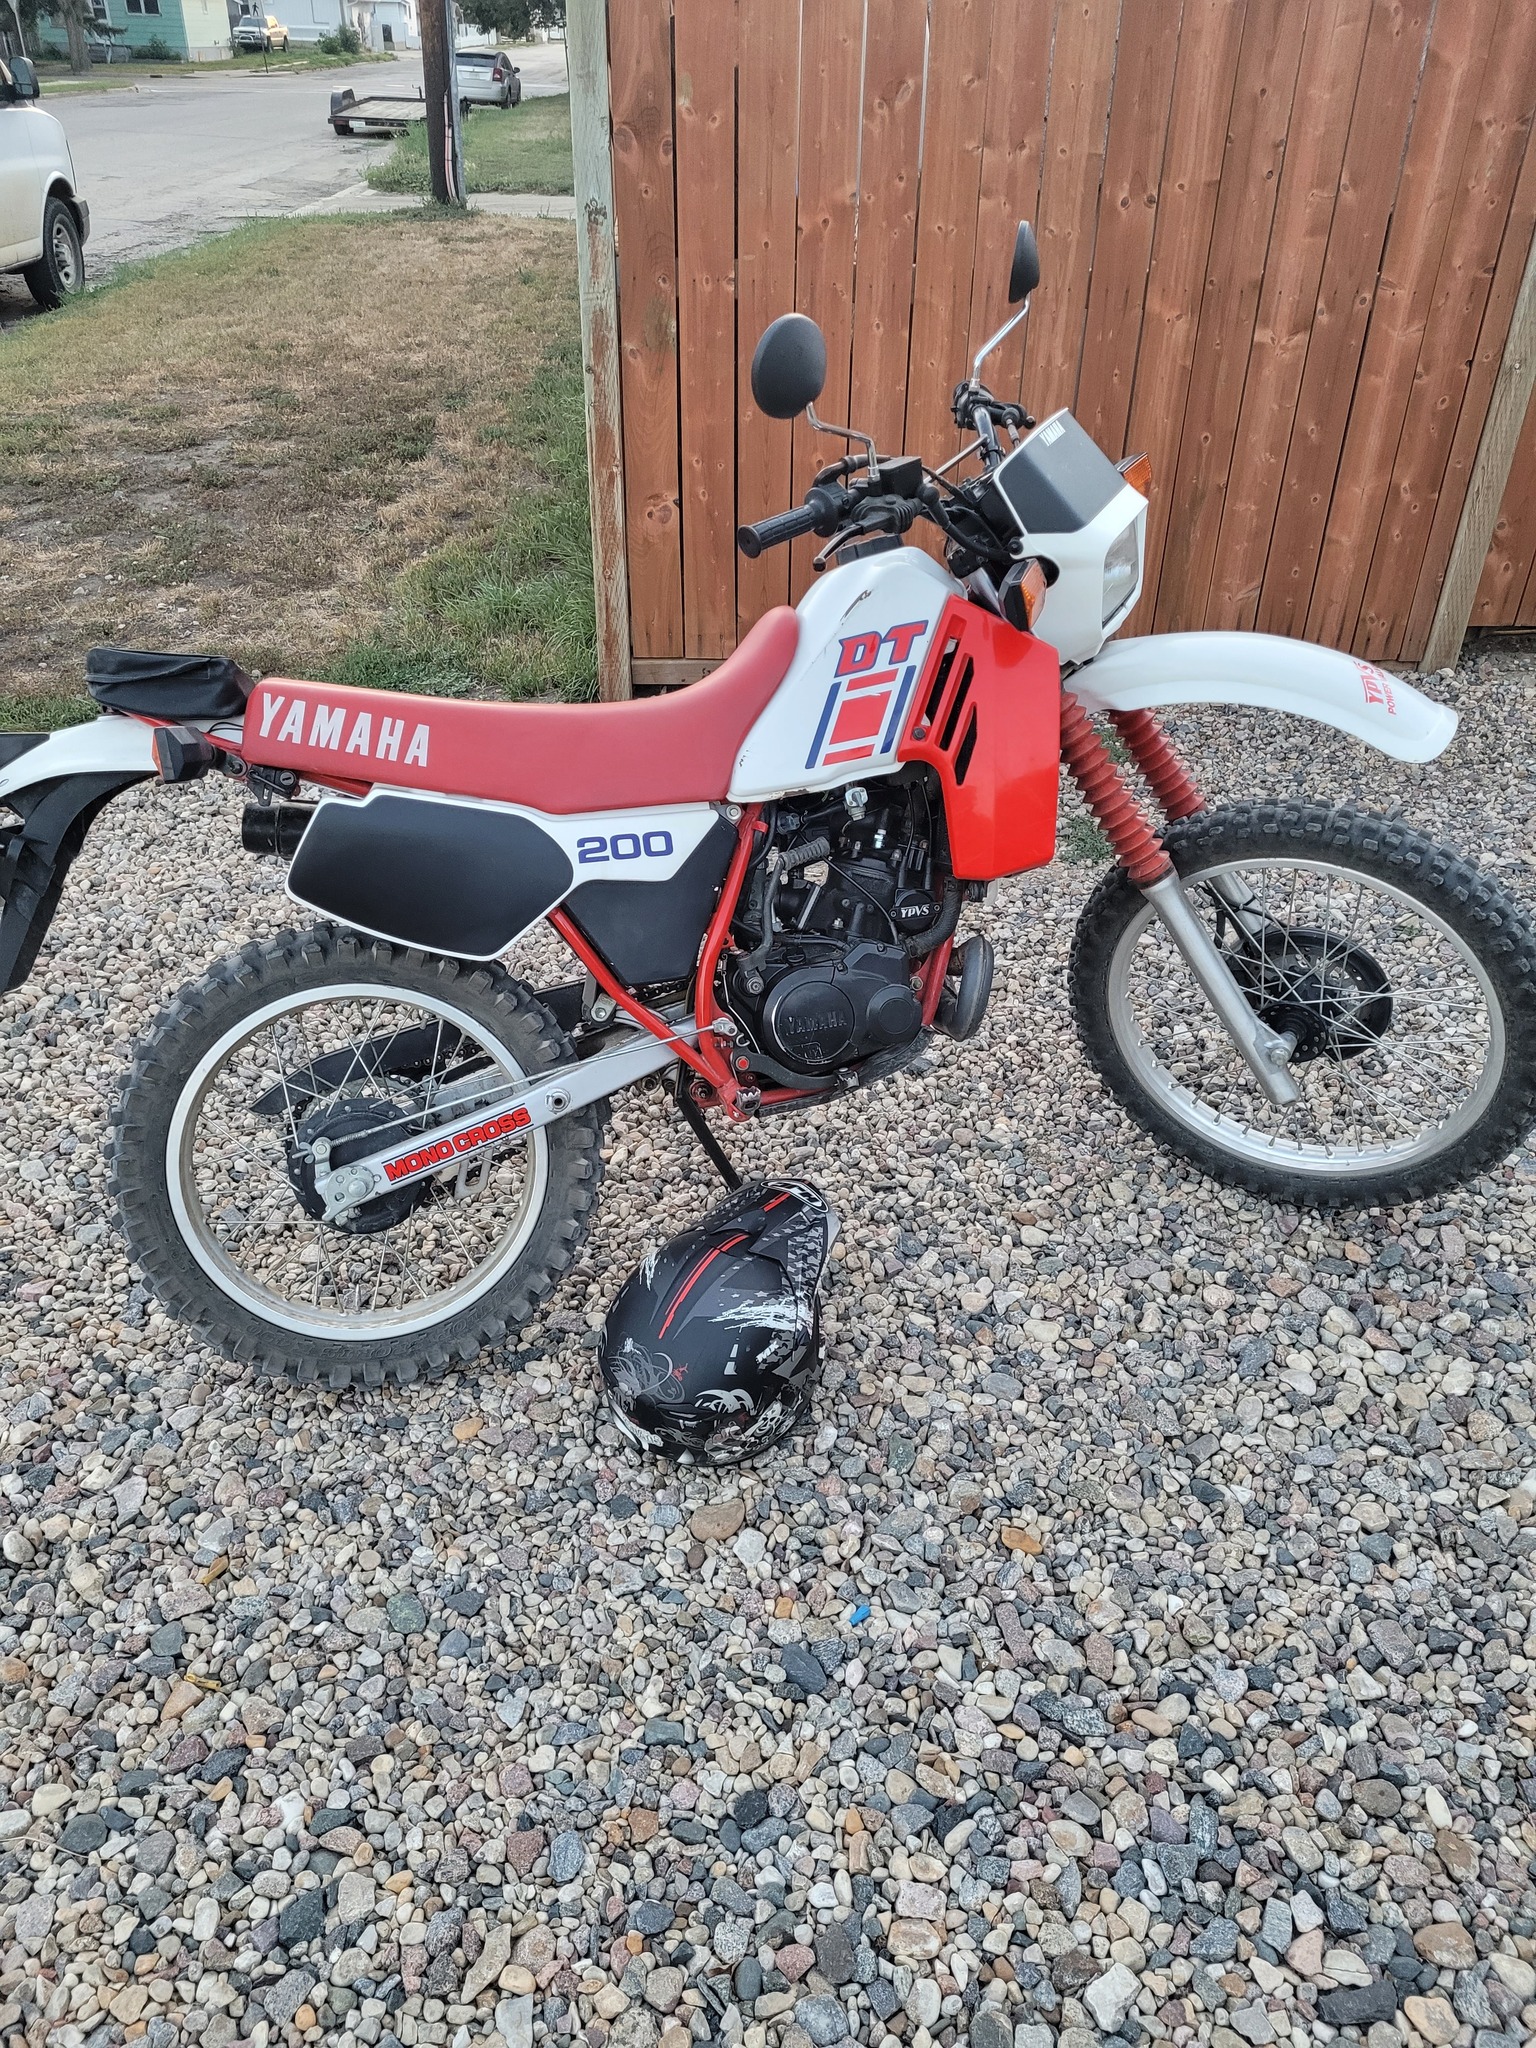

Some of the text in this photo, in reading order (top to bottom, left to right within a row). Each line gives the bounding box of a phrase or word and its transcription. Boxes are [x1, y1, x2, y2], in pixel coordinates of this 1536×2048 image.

[834, 620, 929, 678] DT
[258, 691, 430, 768] YAMAHA
[576, 829, 675, 865] 200
[900, 903, 930, 918] YPVS
[383, 1107, 532, 1182] MONO CROSS
